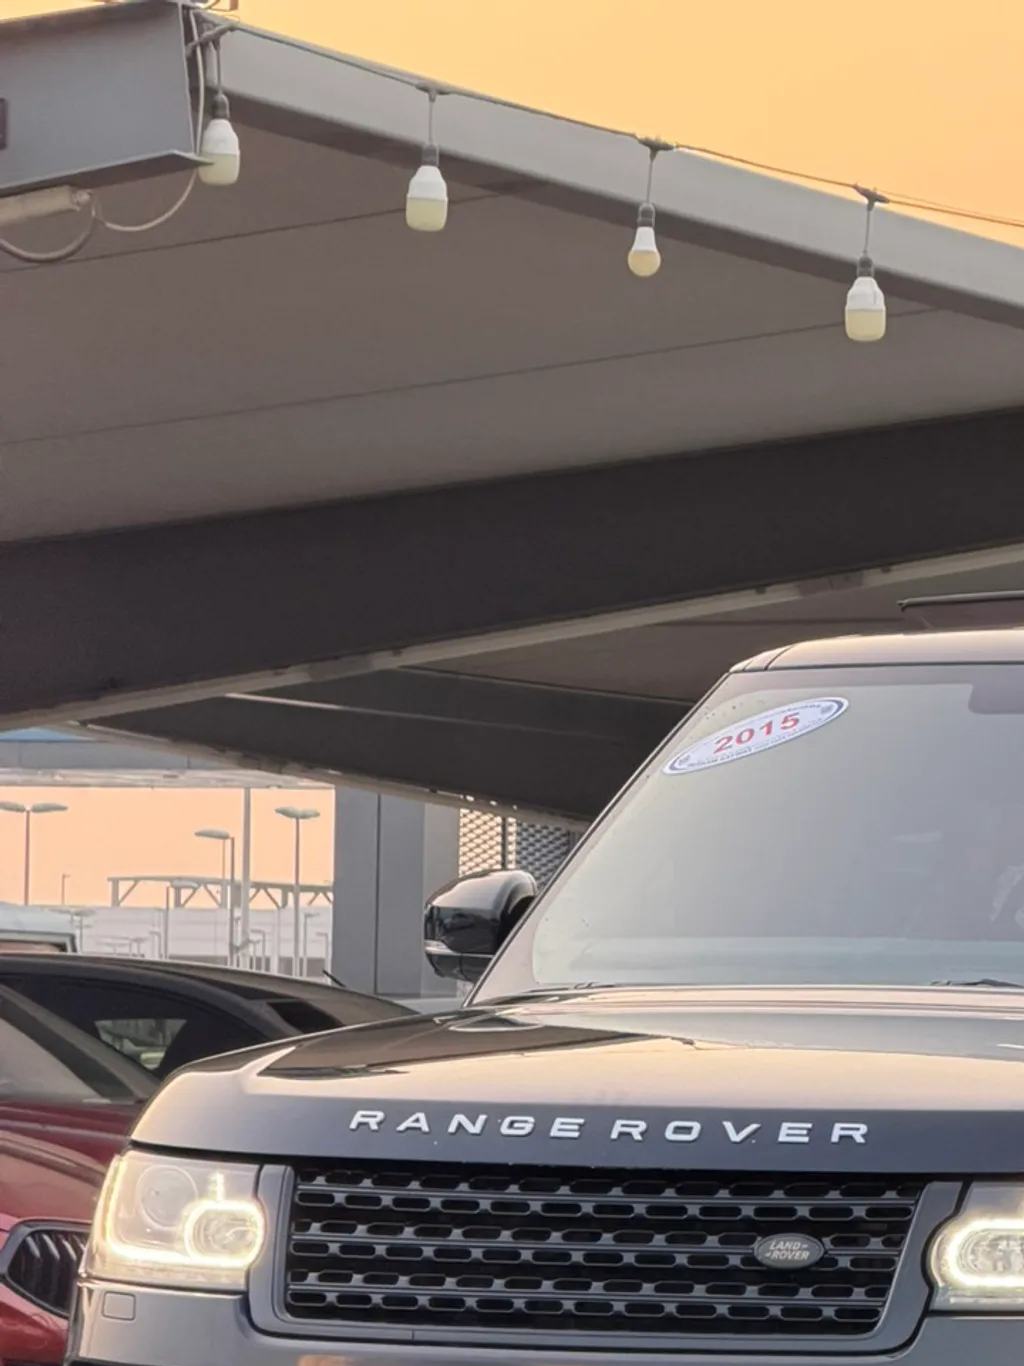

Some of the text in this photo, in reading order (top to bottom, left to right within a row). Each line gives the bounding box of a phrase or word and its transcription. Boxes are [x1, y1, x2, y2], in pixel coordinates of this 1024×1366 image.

[713, 711, 801, 754] 2015
[349, 1109, 869, 1145] RANGE ROVER
